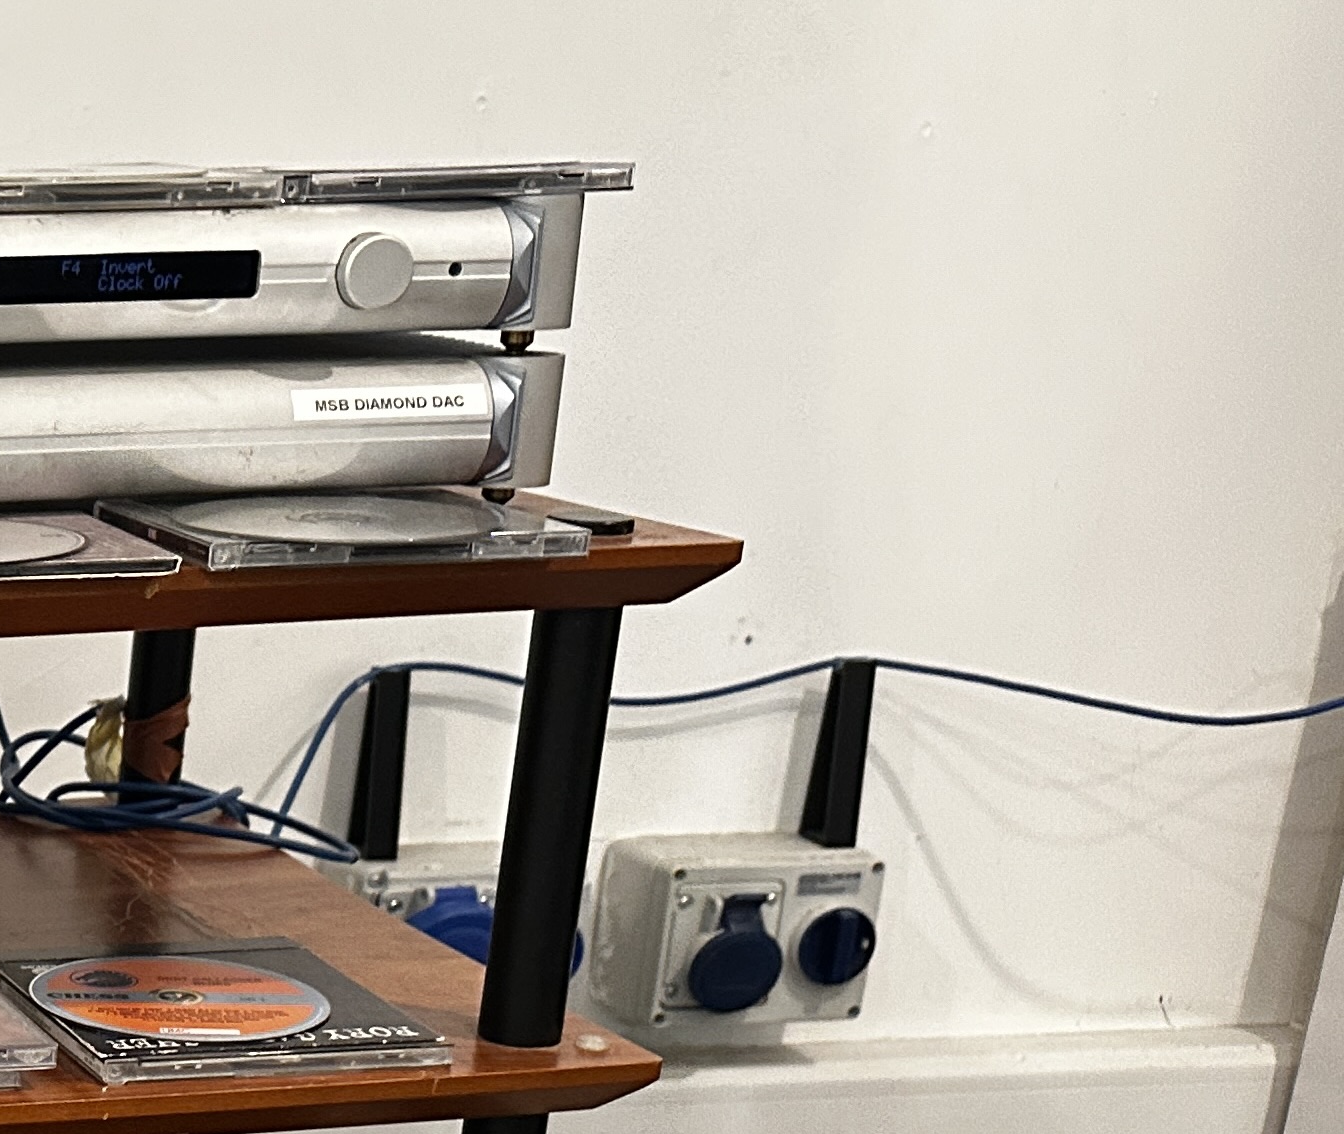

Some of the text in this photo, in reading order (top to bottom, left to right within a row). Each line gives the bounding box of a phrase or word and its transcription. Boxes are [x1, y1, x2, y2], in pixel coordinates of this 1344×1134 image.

[100, 258, 156, 275] Invert
[98, 276, 143, 291] Clock
[154, 274, 183, 289] Off
[315, 395, 465, 412] MSB DIAMOND DAC
[324, 1025, 419, 1041] RORY
